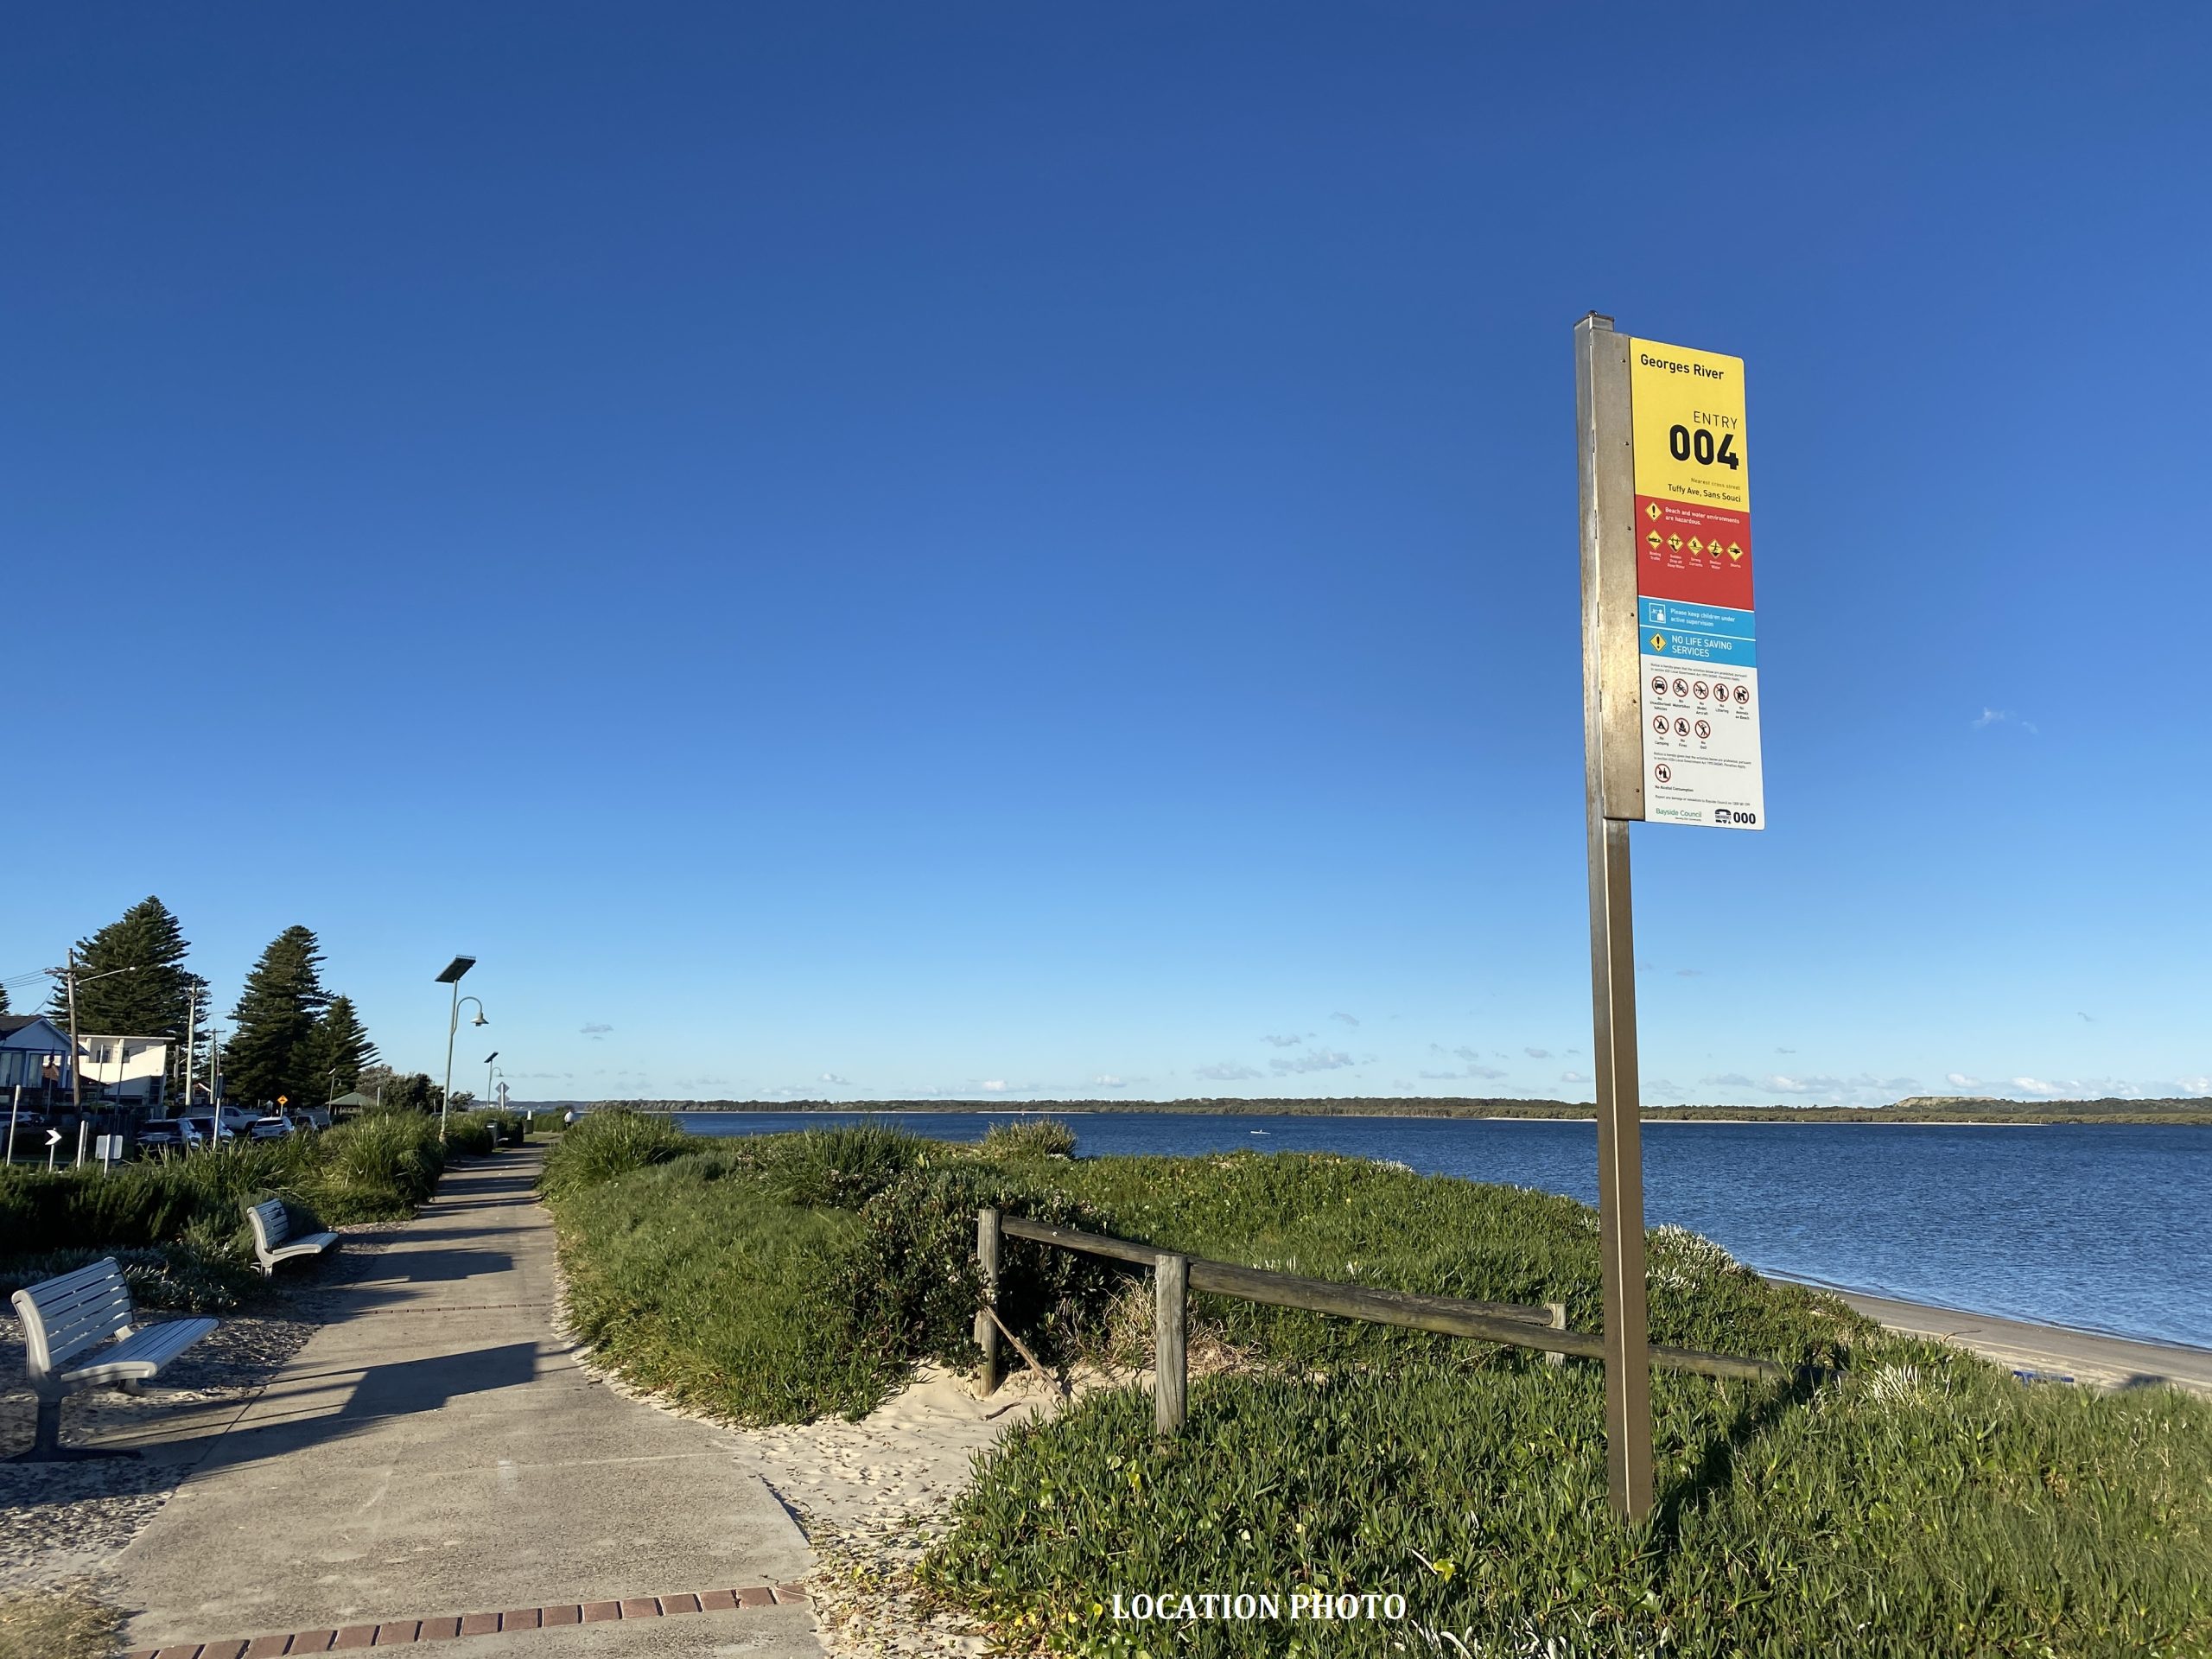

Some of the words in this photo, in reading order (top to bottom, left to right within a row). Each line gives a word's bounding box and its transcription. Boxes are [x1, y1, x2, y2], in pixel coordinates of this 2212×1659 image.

[1640, 353, 1690, 373] Georges
[1693, 364, 1724, 380] River
[1694, 410, 1738, 430] ENTRY
[1669, 424, 1739, 470] 004
[1668, 484, 1686, 494] Tuffy
[1687, 486, 1702, 497] Ave,
[1703, 489, 1720, 499] Sans
[1722, 493, 1741, 502] Souci
[1707, 513, 1740, 524] environments
[1670, 607, 1687, 616] Please
[1700, 612, 1720, 620] children
[1671, 634, 1684, 645] NO
[1686, 637, 1702, 646] LIFE
[1705, 639, 1732, 651] SAVING
[1672, 645, 1710, 658] SERVICES
[1656, 807, 1679, 817] Bayside
[1733, 811, 1757, 824] 000
